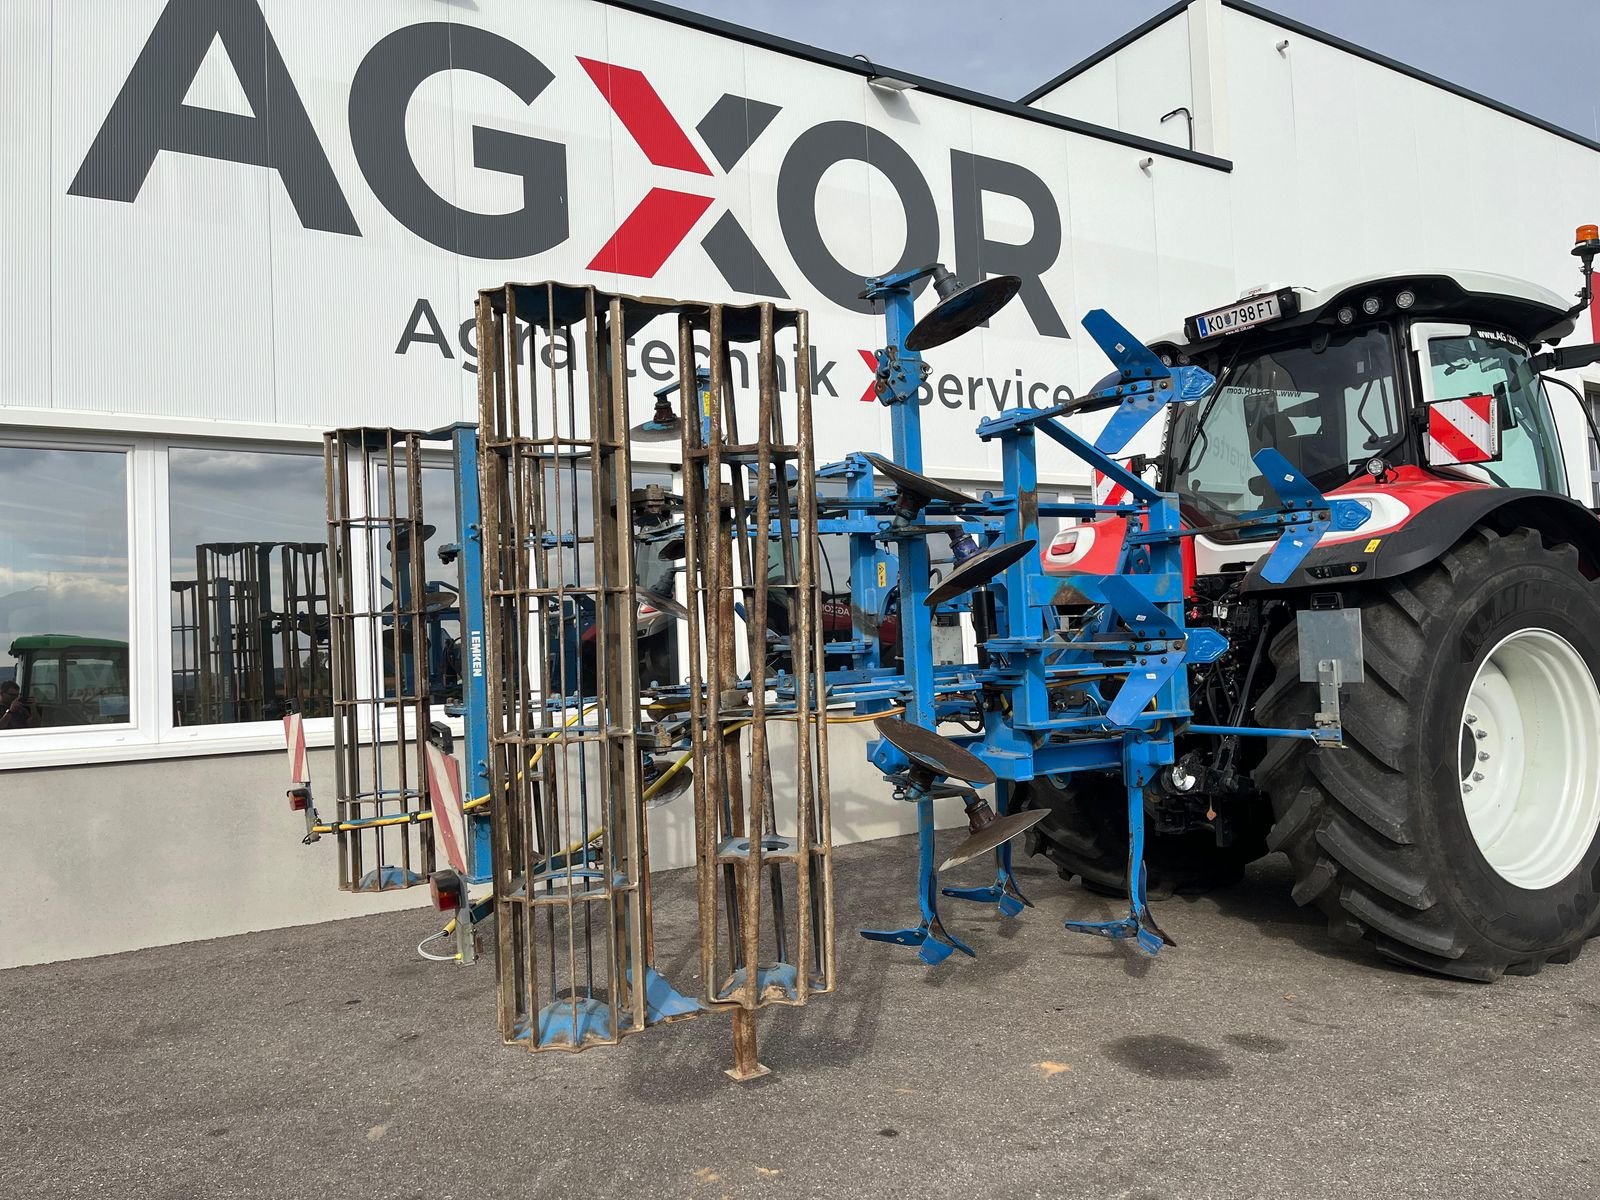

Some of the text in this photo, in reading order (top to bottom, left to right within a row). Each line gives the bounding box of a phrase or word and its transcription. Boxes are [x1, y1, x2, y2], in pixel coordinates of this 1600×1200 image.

[67, 0, 1070, 338] AGXOR
[395, 298, 839, 397] Agraehnk
[1207, 315, 1224, 333] KO
[471, 630, 483, 677] LEMKEN
